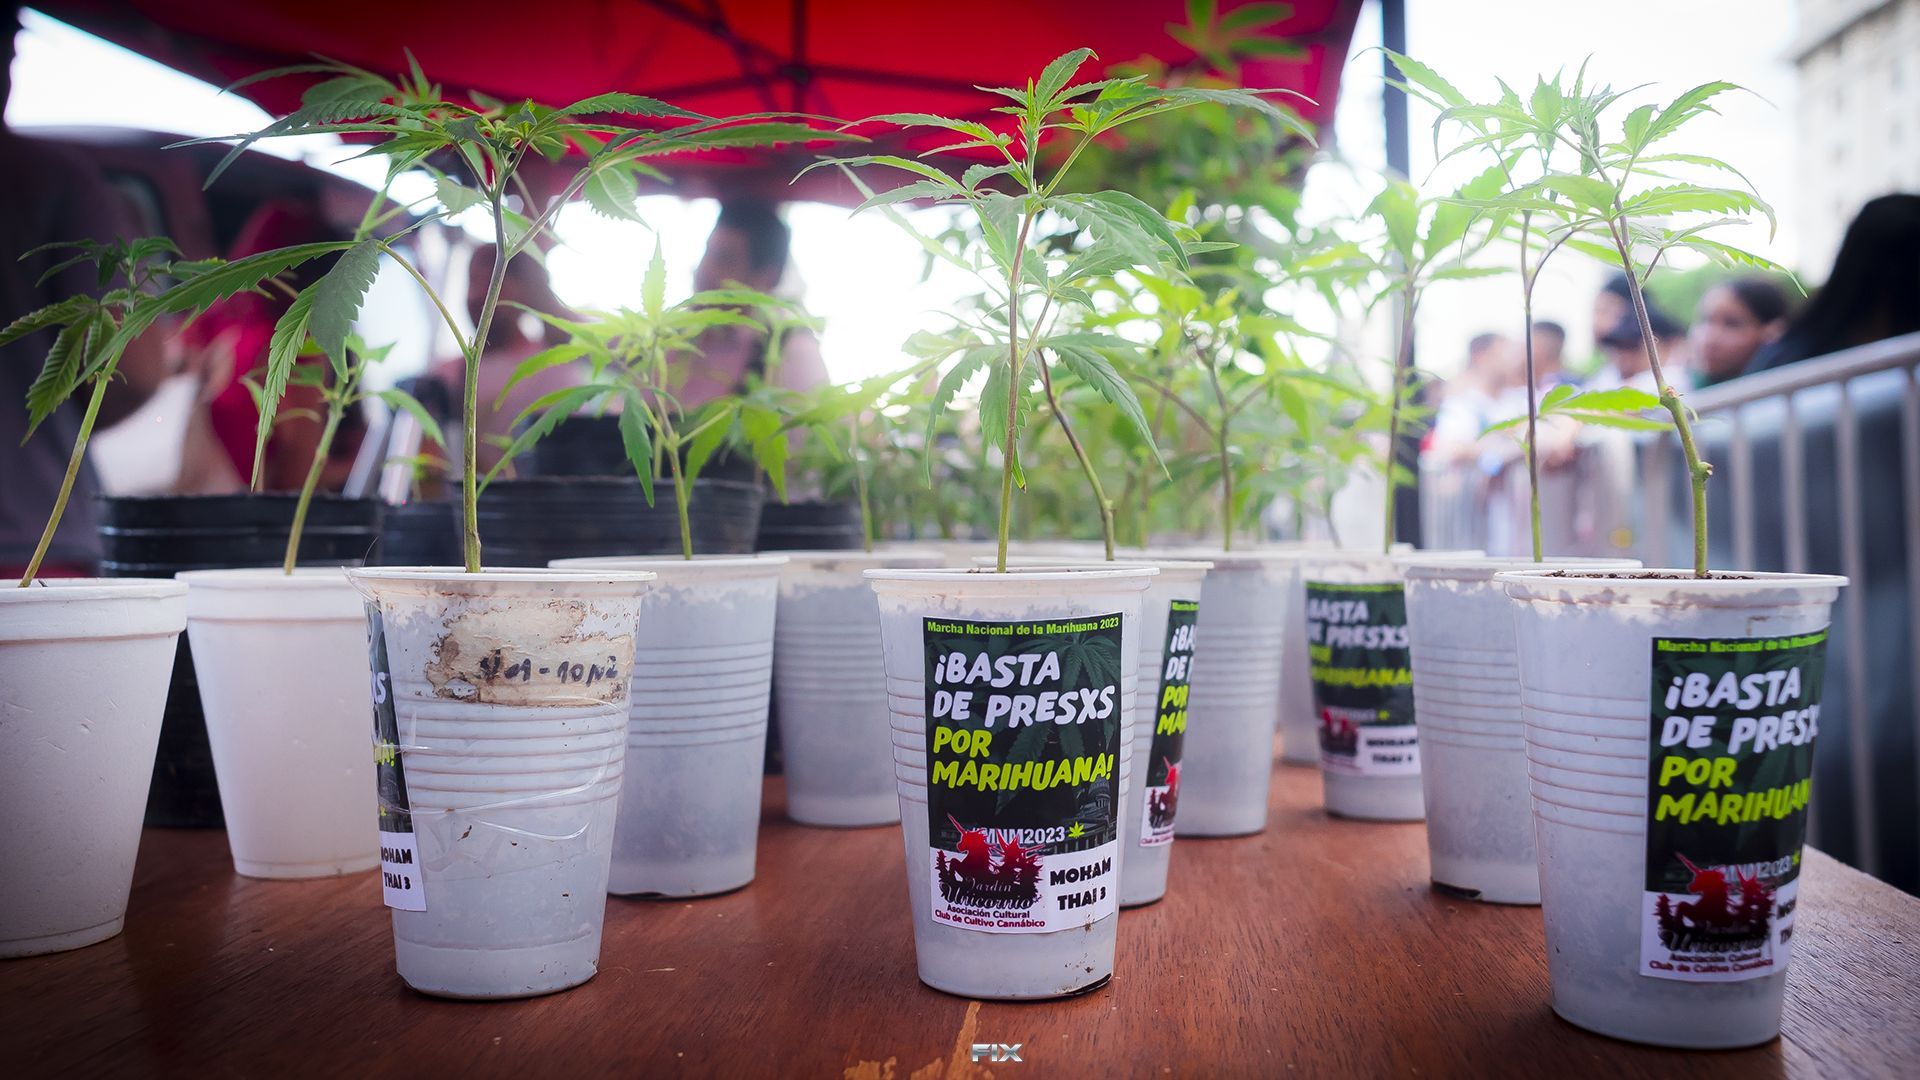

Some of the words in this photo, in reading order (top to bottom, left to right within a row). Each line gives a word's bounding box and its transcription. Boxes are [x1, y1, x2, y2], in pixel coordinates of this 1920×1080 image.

[927, 621, 963, 634] Marcha
[966, 623, 1013, 636] Nacional
[1016, 624, 1030, 636] de
[1033, 624, 1043, 635] la
[1046, 621, 1098, 634] Marihuana
[1099, 617, 1119, 629] 2023
[934, 651, 1060, 688] ¡BASTA
[1665, 666, 1801, 711] ¡BASTA
[933, 690, 973, 720] DE
[984, 685, 1115, 728] PRESXS
[933, 726, 993, 758] POR
[1660, 715, 1717, 748] DE
[932, 753, 1114, 791] MARIHUANA!
[1658, 755, 1738, 789] POR
[384, 871, 403, 890] THAI
[1050, 856, 1111, 886] MOHAM
[947, 904, 990, 918] Asociación
[992, 910, 1030, 919] Cultural
[1057, 887, 1097, 910] THAI
[935, 909, 951, 920] Club
[952, 914, 963, 923] de
[964, 917, 995, 928] Cultivo
[997, 919, 1046, 928] Cannábico
